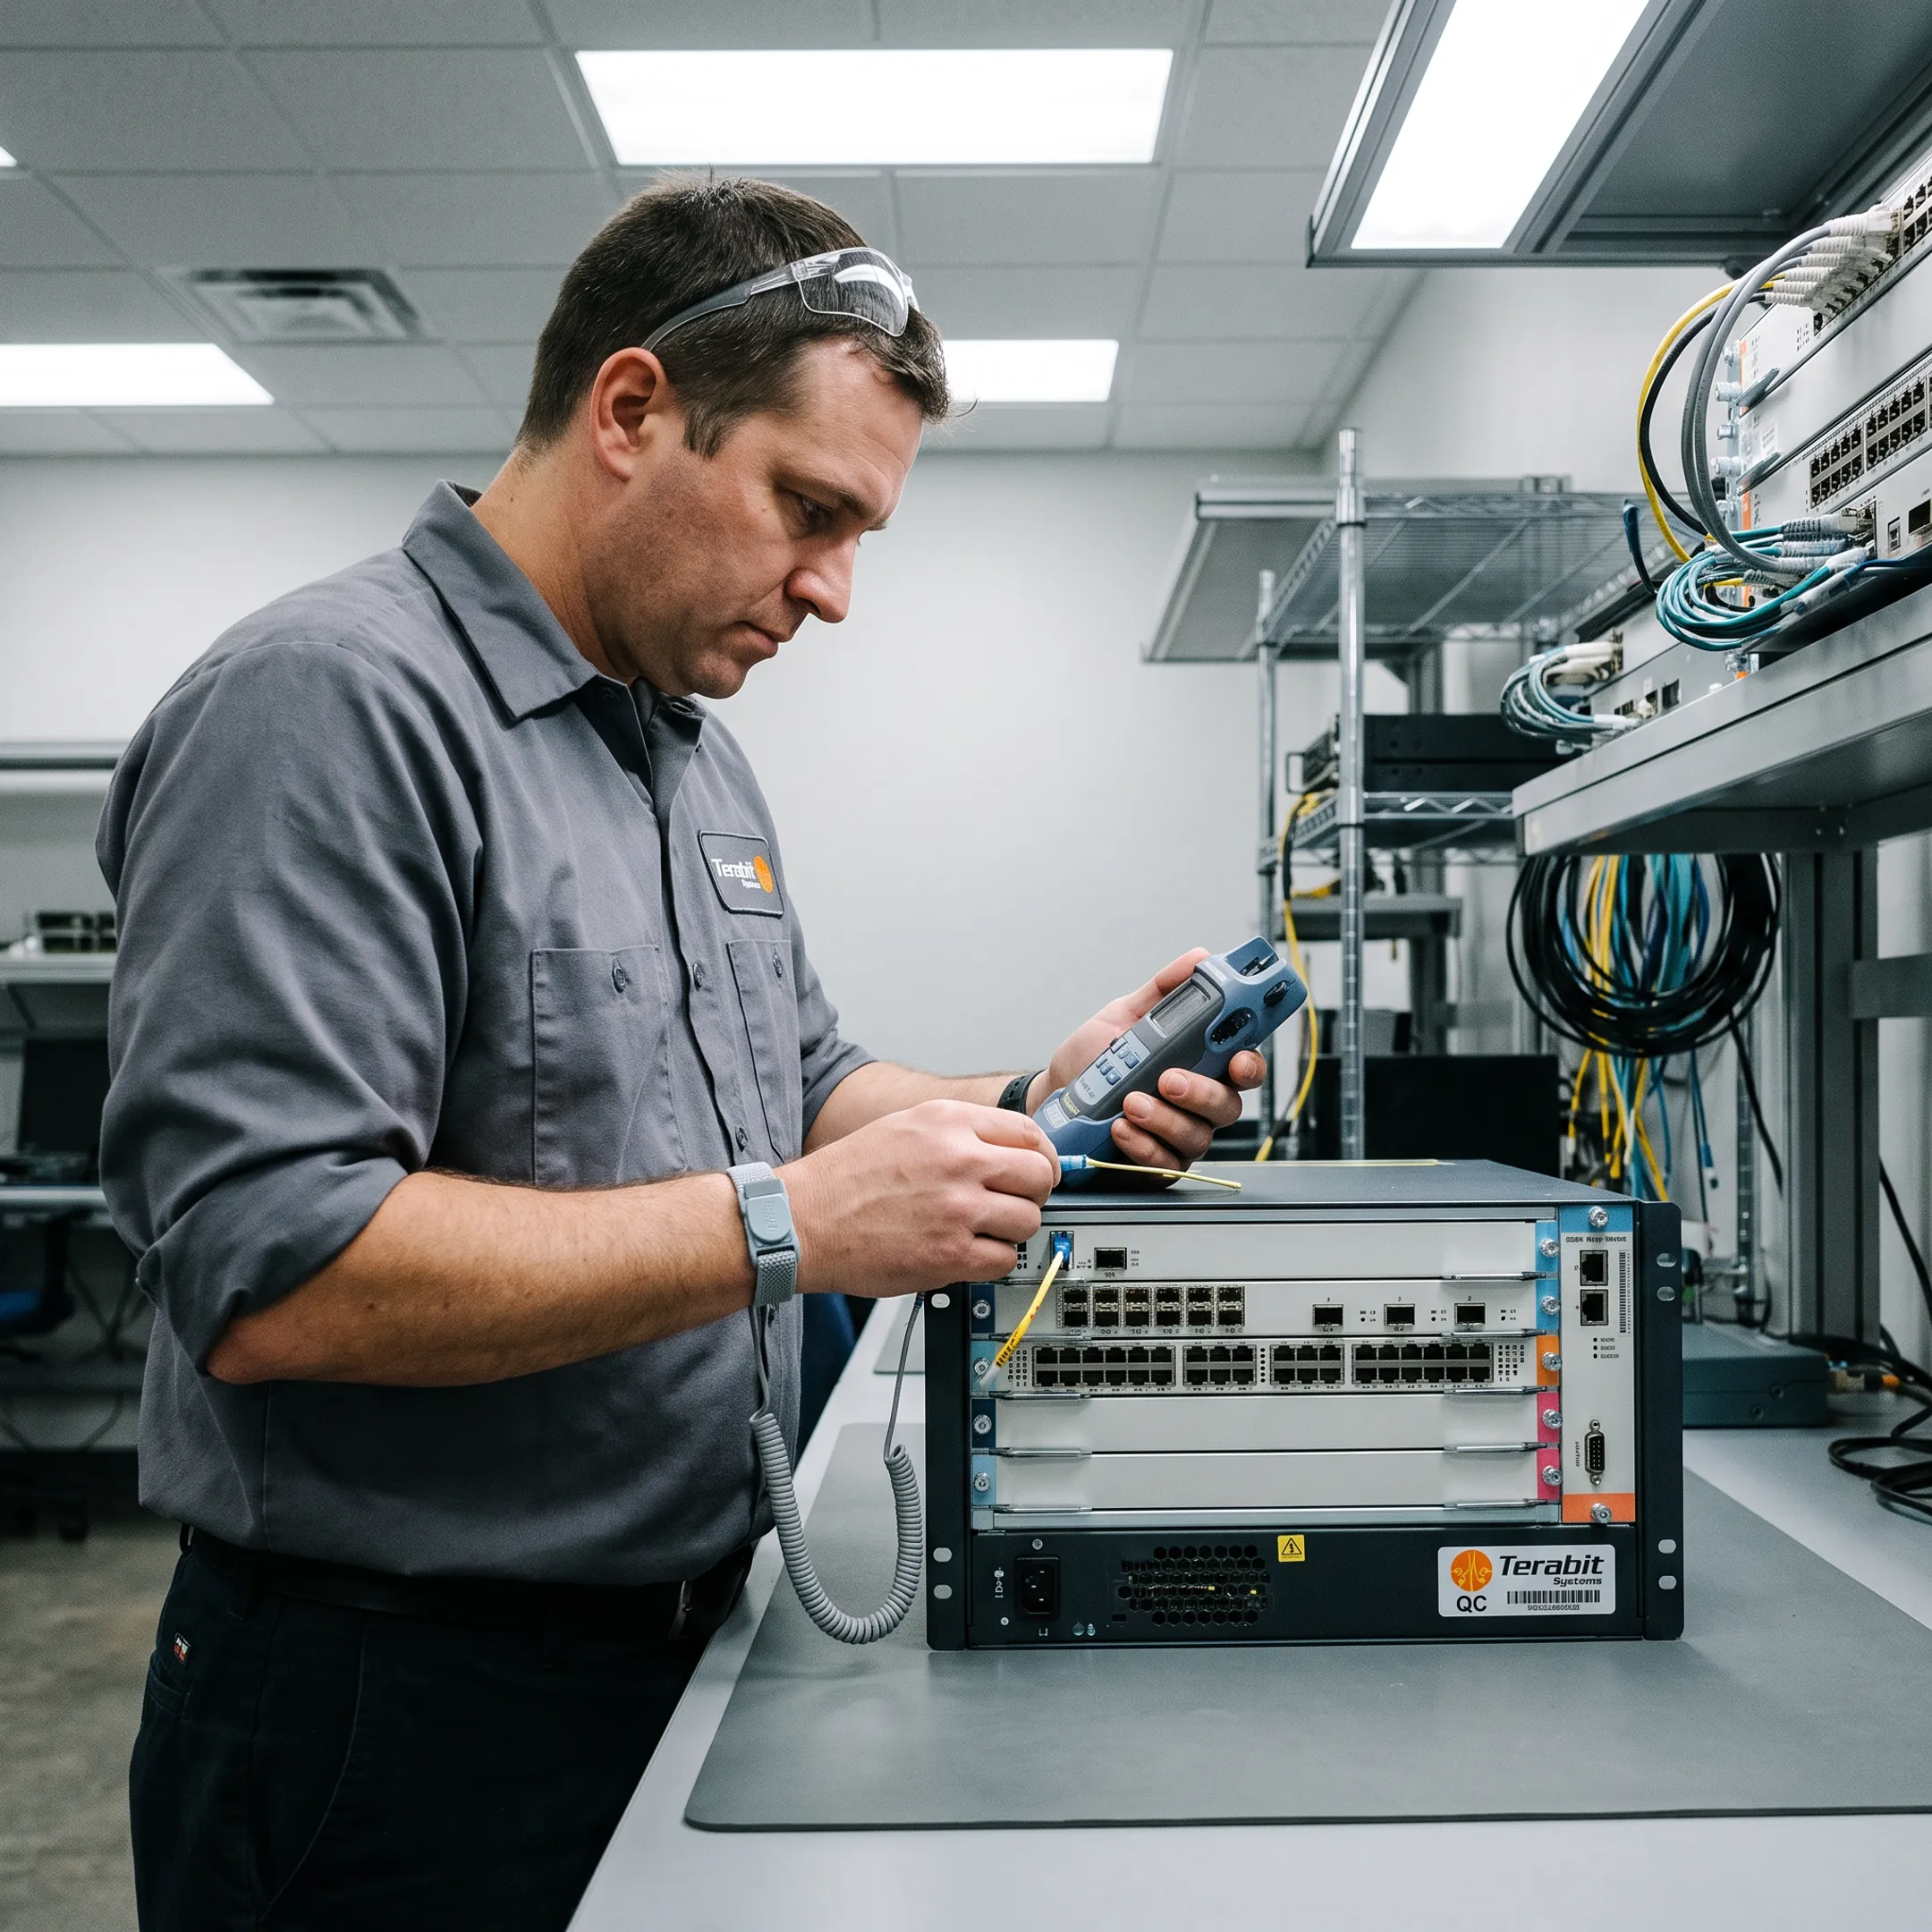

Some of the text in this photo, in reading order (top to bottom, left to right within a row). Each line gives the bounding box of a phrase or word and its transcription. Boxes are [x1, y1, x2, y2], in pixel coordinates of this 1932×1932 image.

[710, 858, 757, 879] Terabit
[1499, 1555, 1605, 1576] Terabit
[1456, 1595, 1487, 1614] QC
